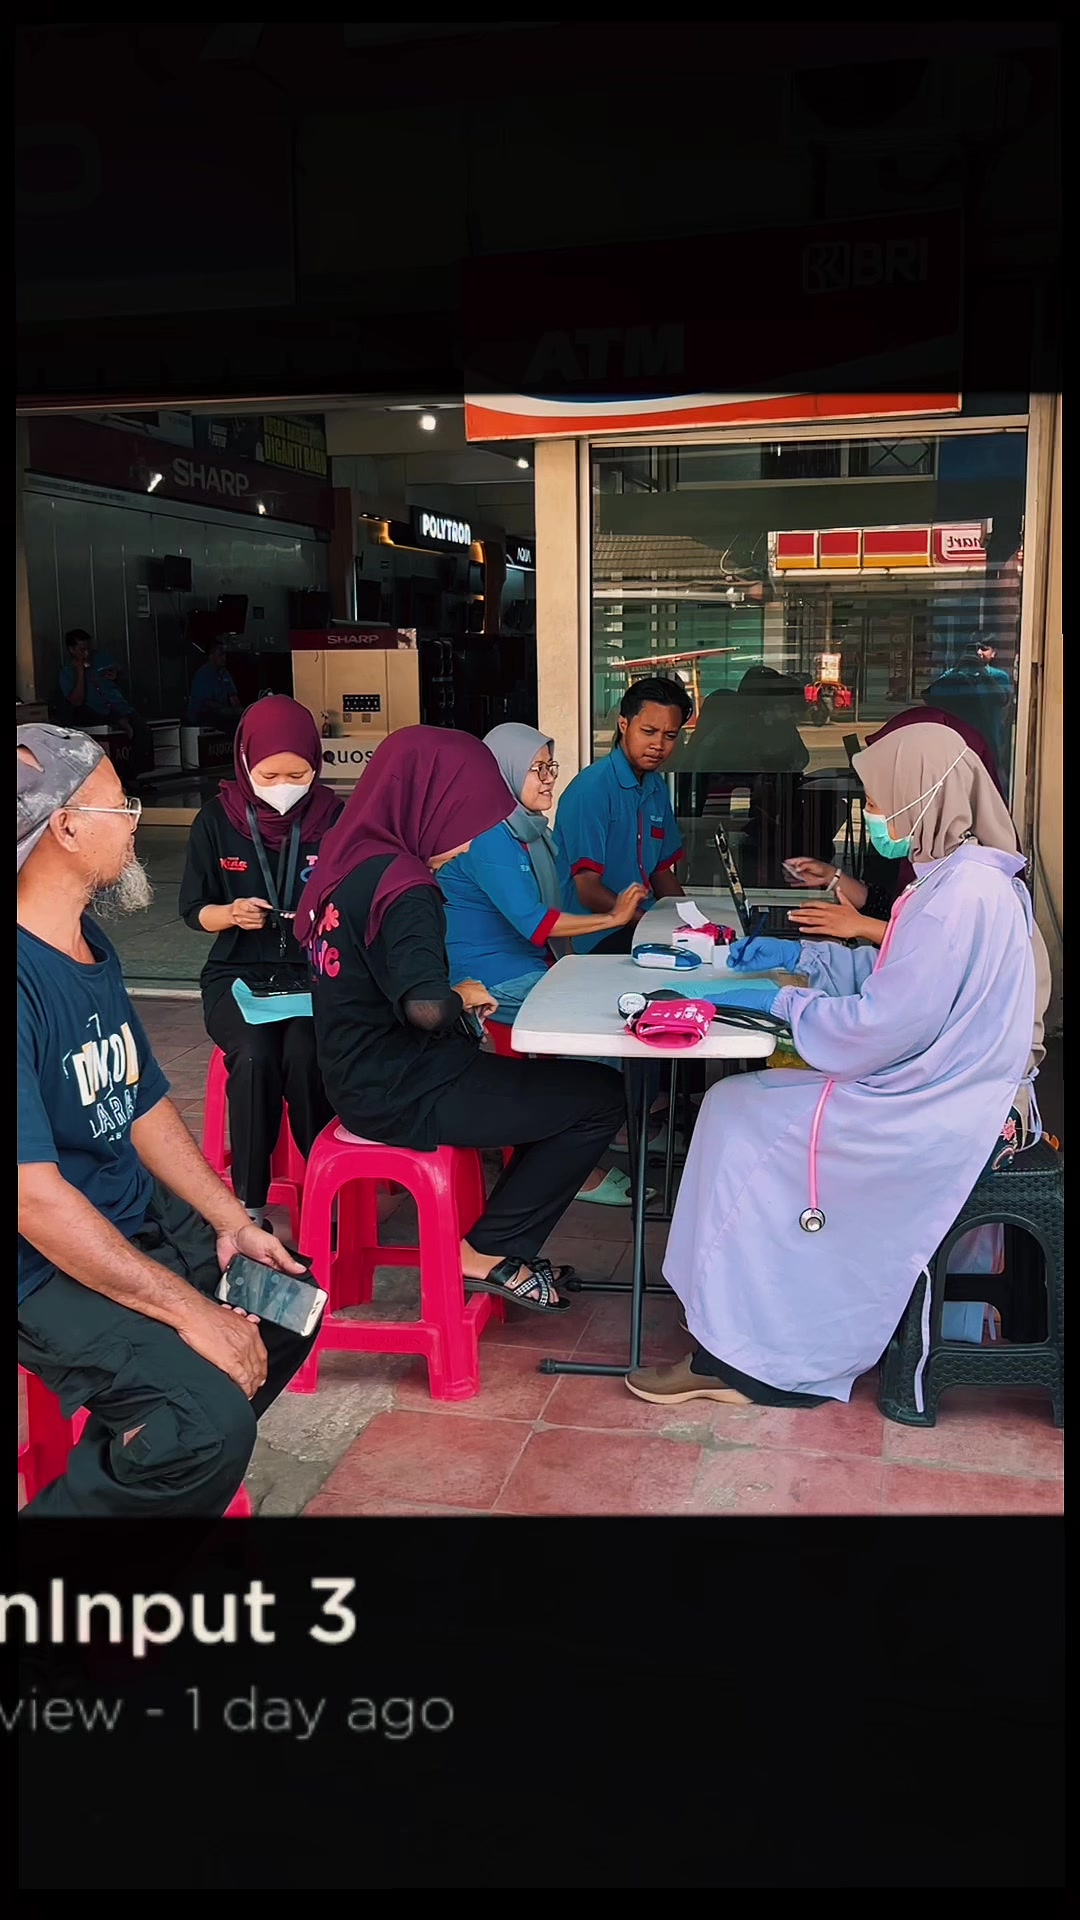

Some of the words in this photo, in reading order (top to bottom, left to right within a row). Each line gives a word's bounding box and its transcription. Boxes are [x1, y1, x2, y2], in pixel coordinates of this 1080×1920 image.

[853, 236, 929, 287] BRI
[522, 320, 686, 384] ATM
[172, 457, 250, 498] SHARP
[422, 513, 472, 546] POLYTRON
[327, 635, 379, 645] SHARP
[323, 750, 374, 766] QUOS
